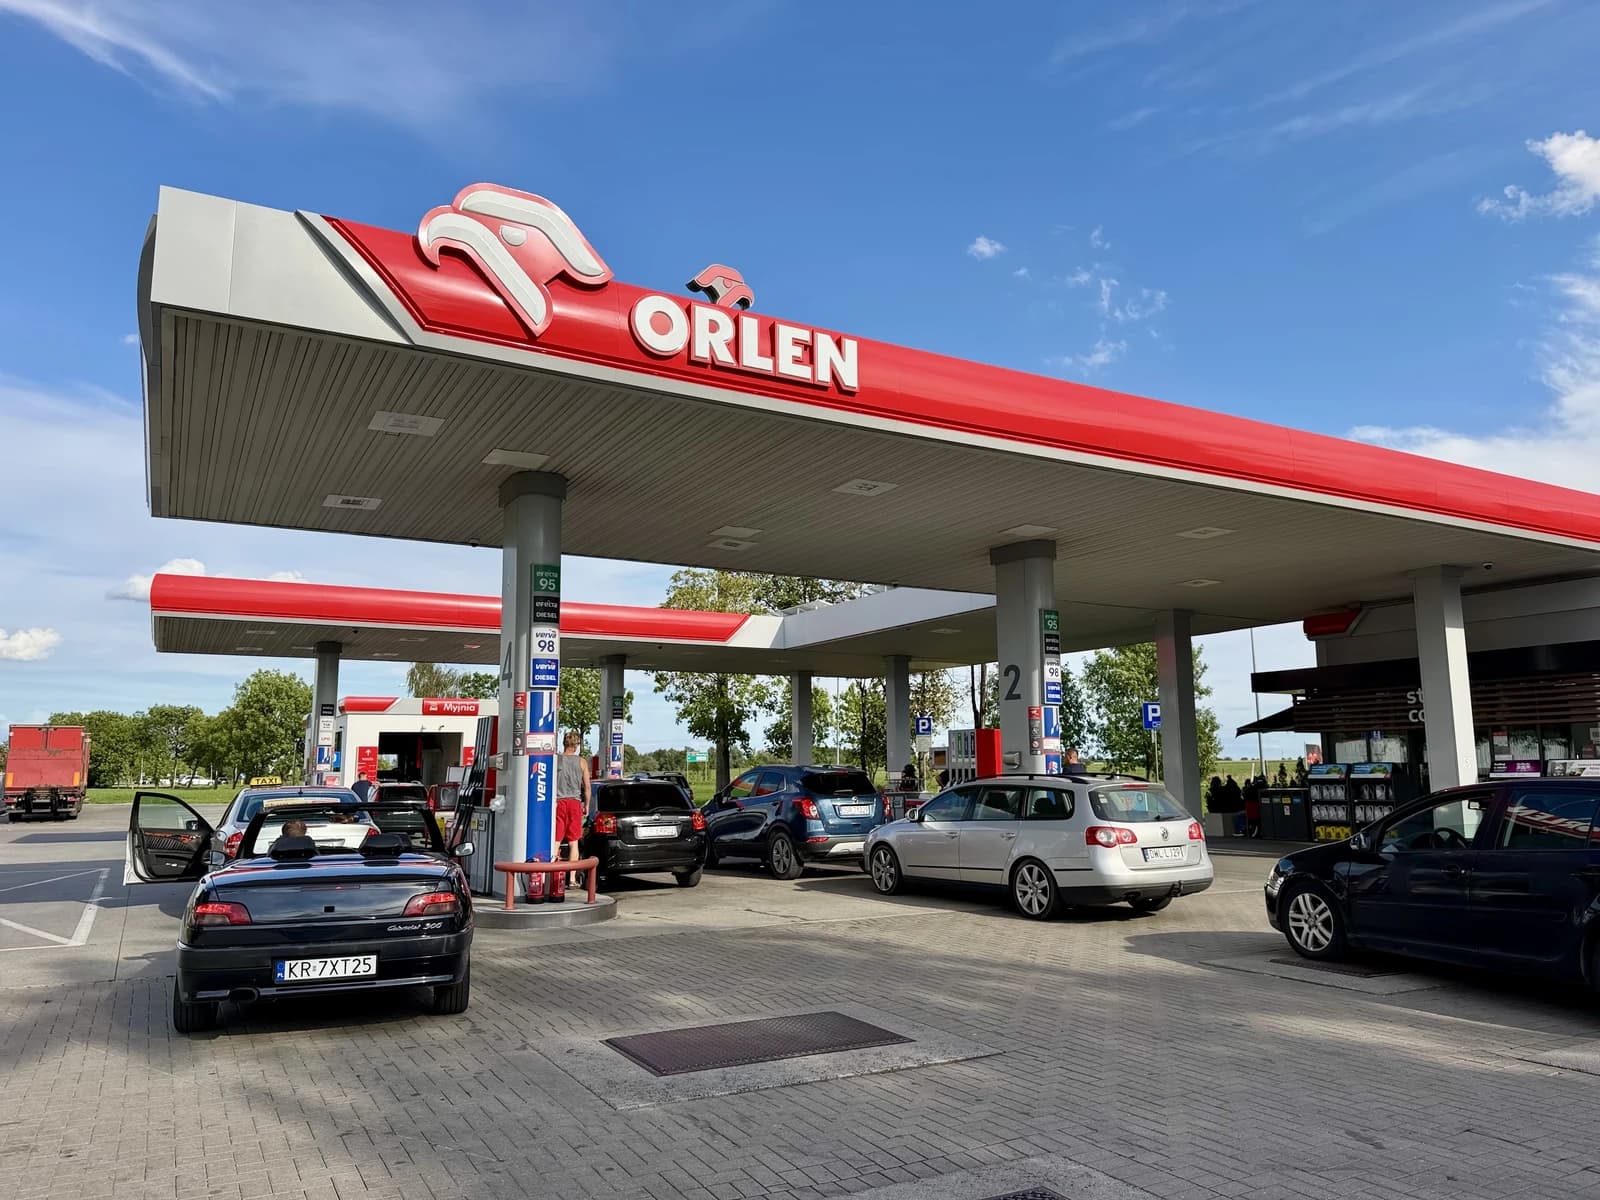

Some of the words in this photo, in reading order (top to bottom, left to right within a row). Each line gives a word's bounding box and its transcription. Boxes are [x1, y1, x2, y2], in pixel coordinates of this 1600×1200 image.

[632, 295, 859, 389] ORLEN
[539, 578, 556, 591] 95
[535, 611, 557, 619] DIESEL
[1047, 619, 1058, 630] 95
[535, 630, 557, 639] verva
[537, 639, 555, 653] 98
[502, 641, 513, 689] 4
[535, 662, 556, 670] verva
[1048, 667, 1060, 678] 98
[1003, 664, 1021, 701] 2
[443, 702, 476, 713] Myjnia
[1147, 704, 1161, 722] P
[919, 719, 930, 733] P
[255, 777, 278, 785] TAXI
[536, 761, 547, 802] verva
[288, 961, 312, 979] KR
[318, 957, 372, 977] 7XT25
